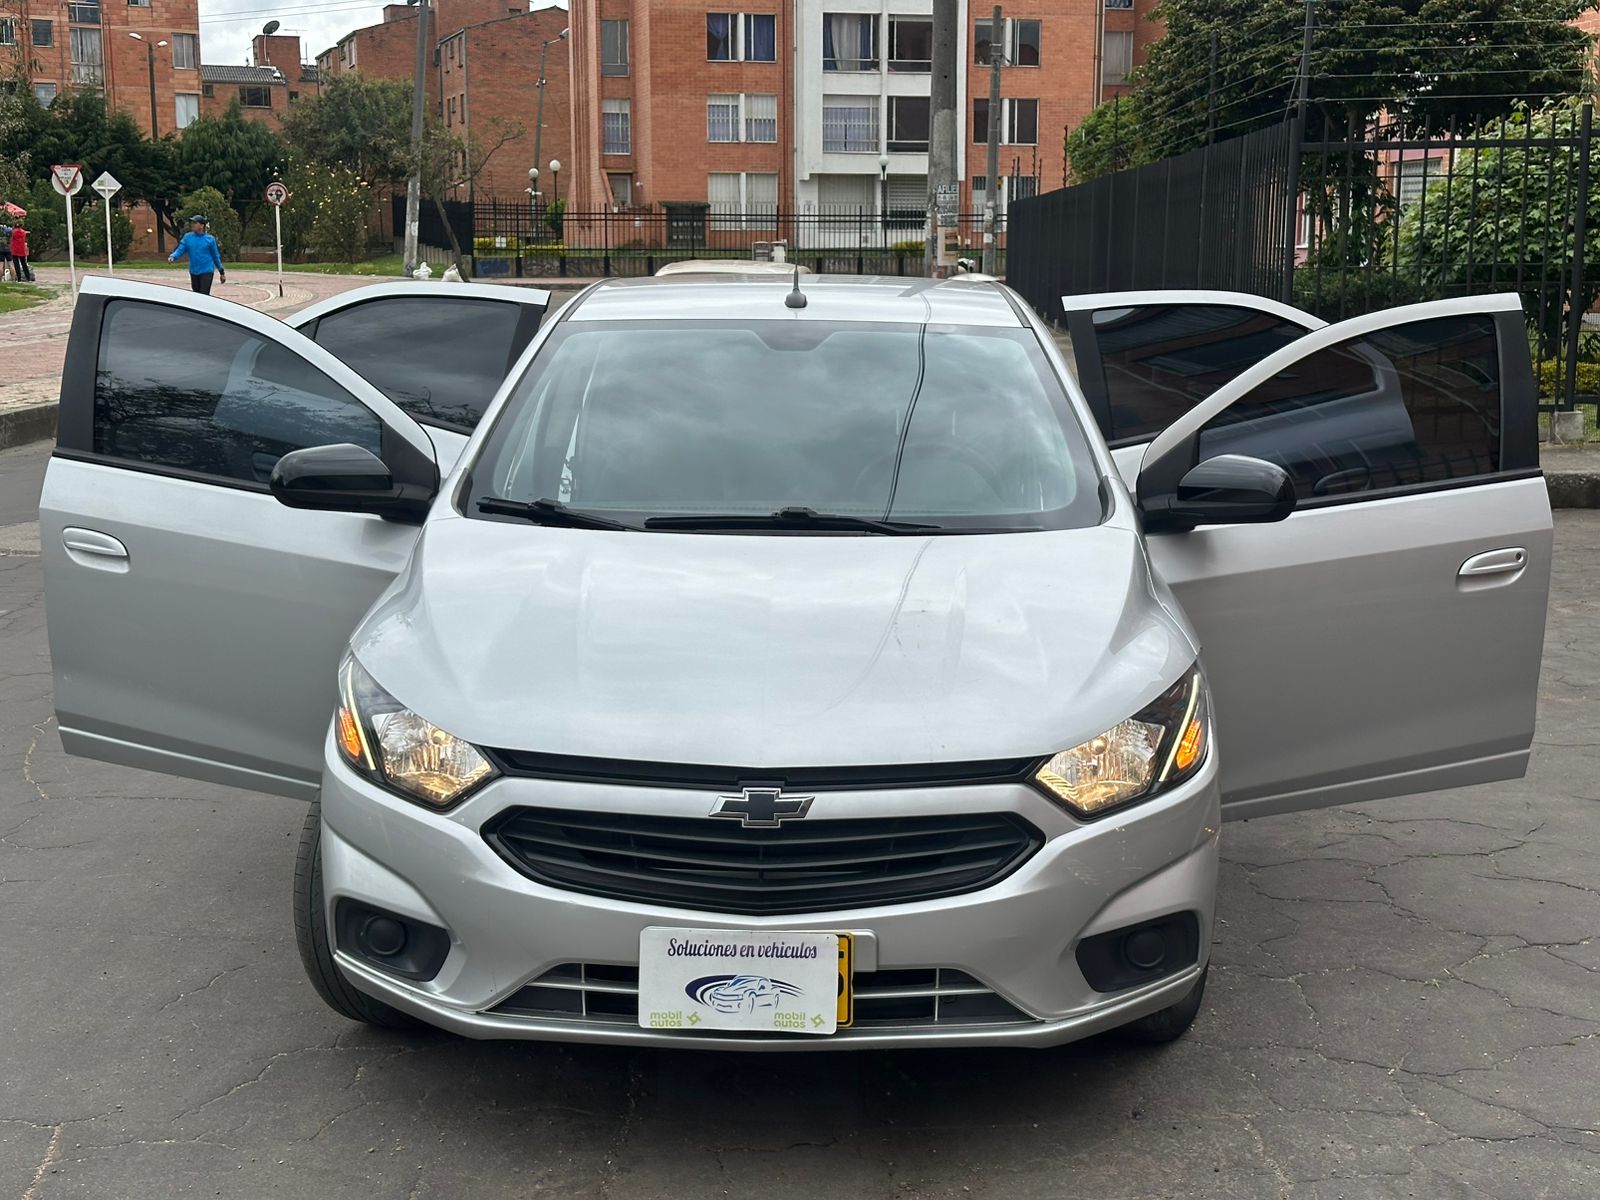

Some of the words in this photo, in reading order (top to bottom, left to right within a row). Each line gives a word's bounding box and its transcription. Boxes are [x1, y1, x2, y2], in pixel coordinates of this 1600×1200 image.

[668, 938, 737, 957] Soluciones
[740, 944, 755, 957] en
[758, 942, 818, 959] vehiculos
[650, 1011, 682, 1020] mobil
[774, 1012, 806, 1021] mobil
[650, 1019, 682, 1028] autos
[774, 1019, 806, 1029] autos
